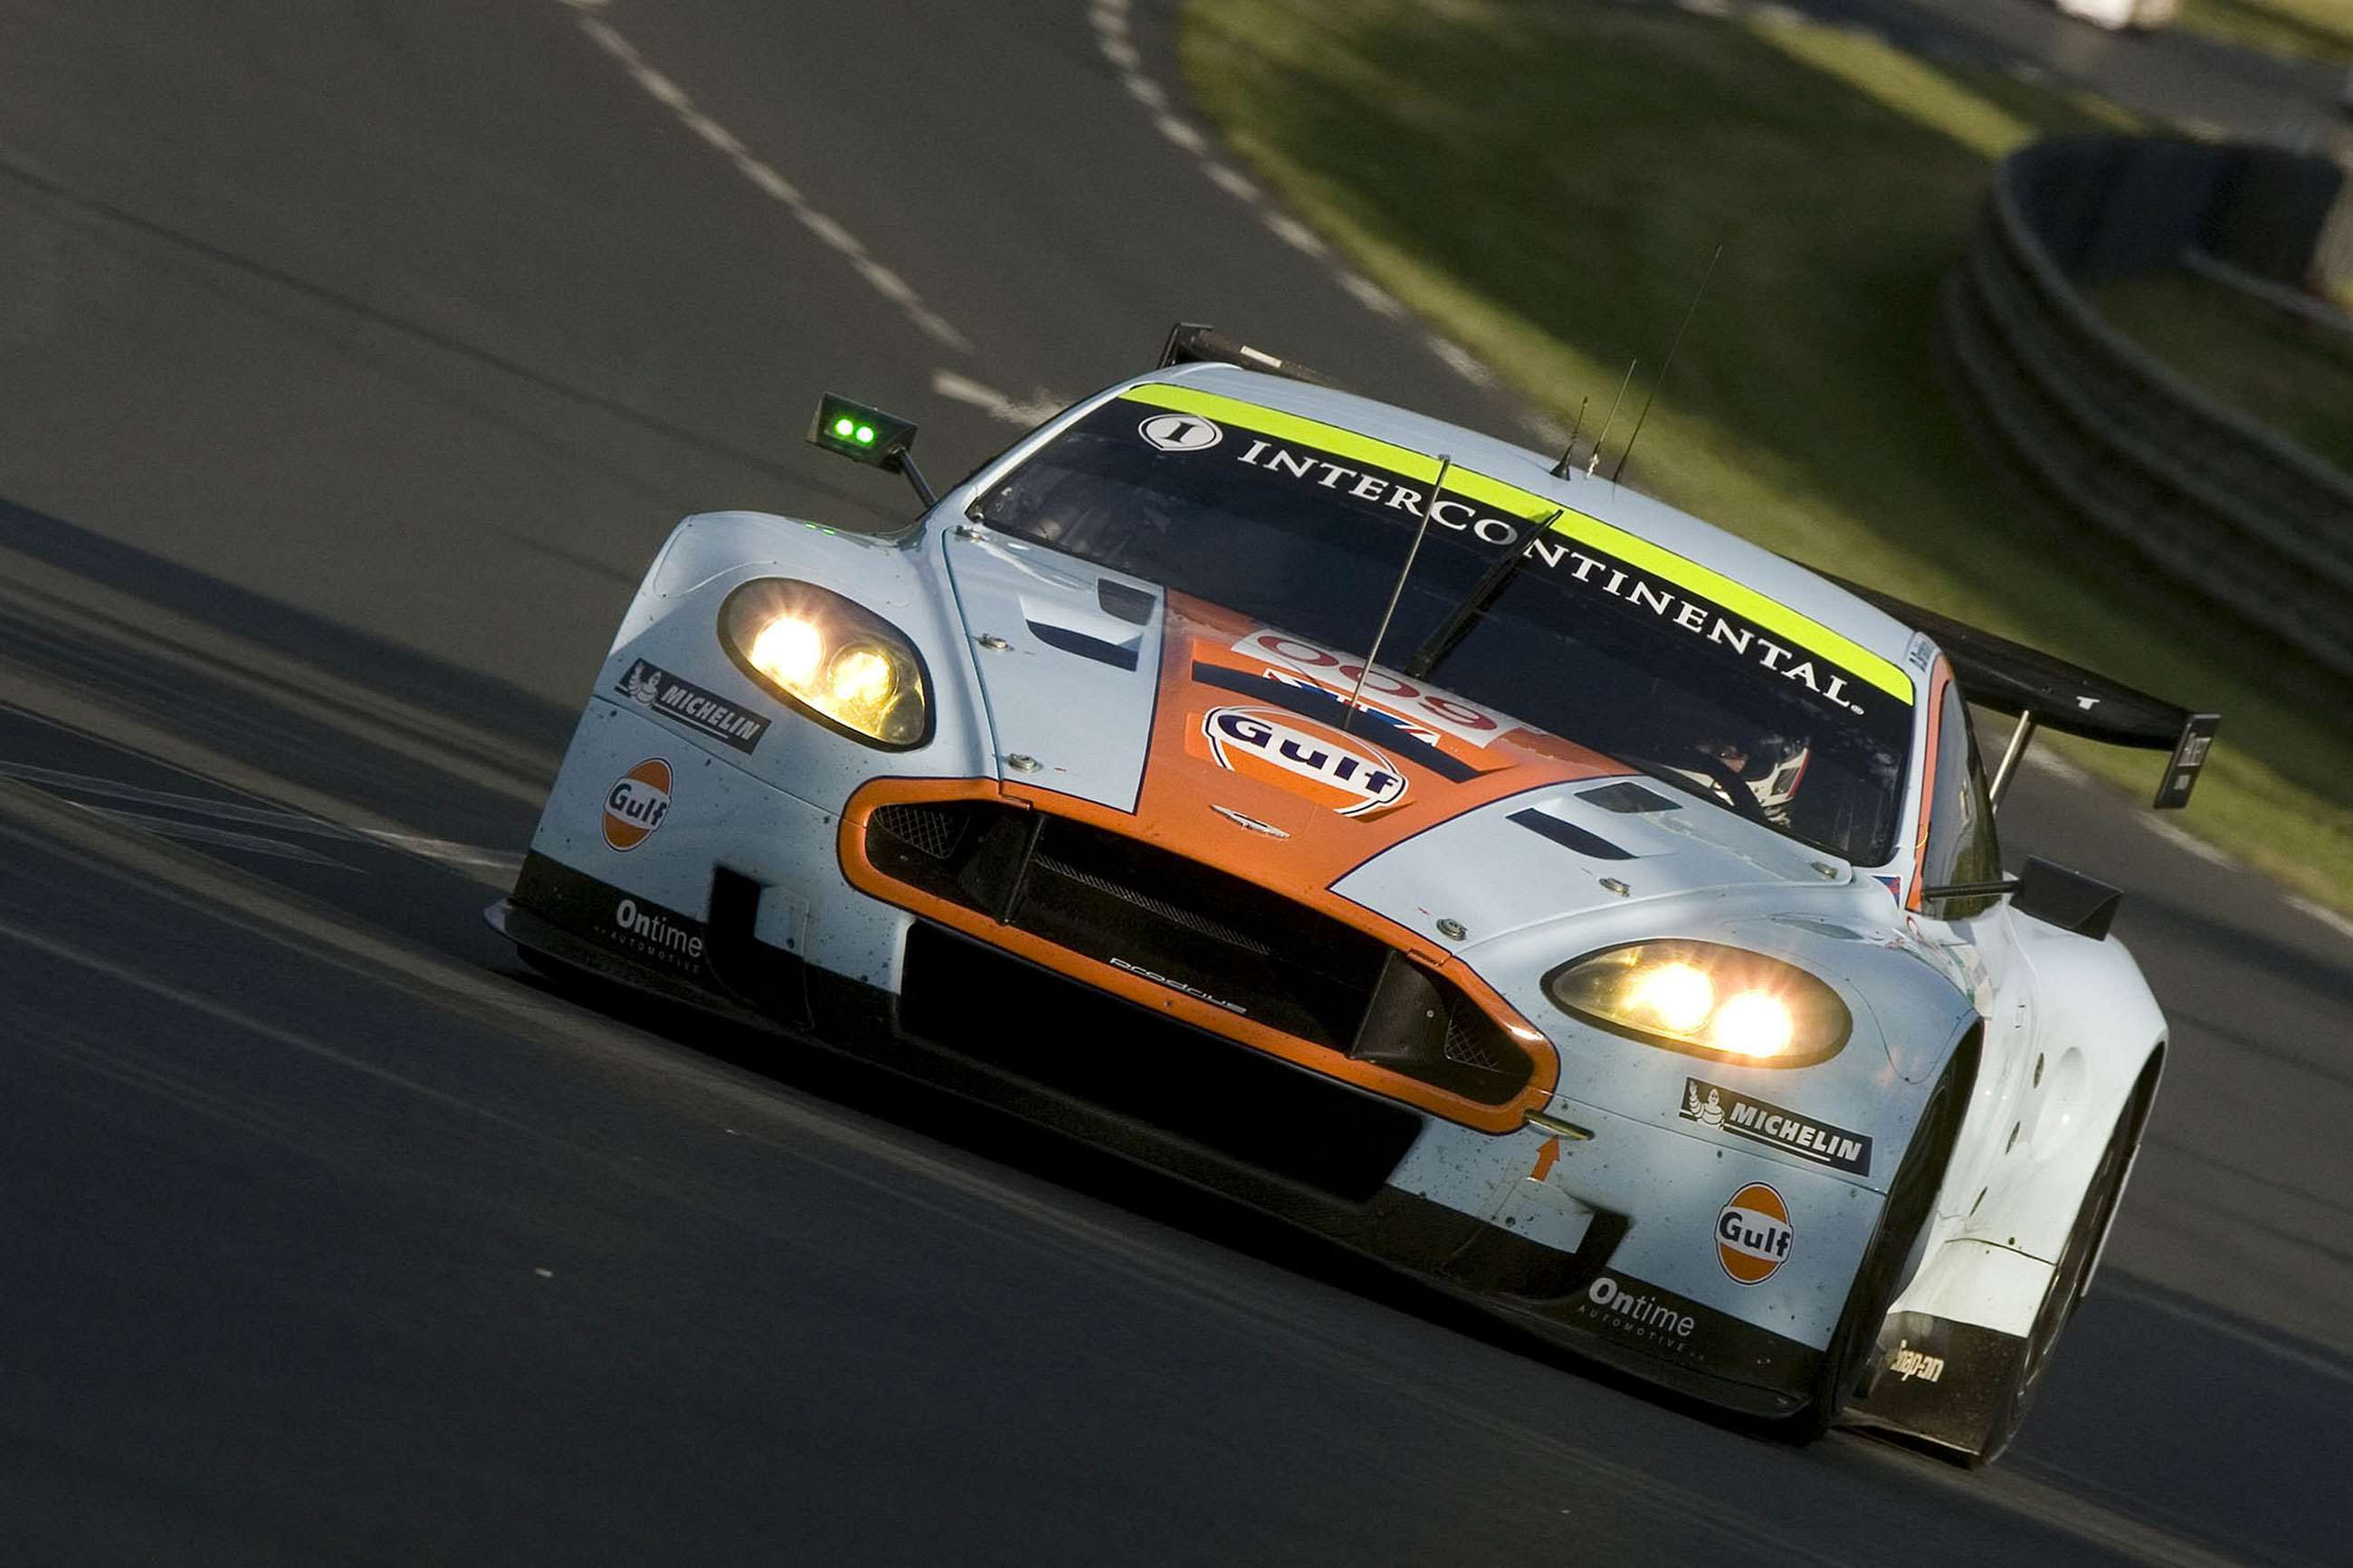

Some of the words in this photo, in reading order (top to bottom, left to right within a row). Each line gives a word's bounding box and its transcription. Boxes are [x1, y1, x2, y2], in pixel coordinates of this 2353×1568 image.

[1257, 635, 1498, 730] 009
[661, 686, 761, 740] MICHELIN
[1217, 714, 1398, 794] Gulf
[609, 783, 667, 826] Gulf
[610, 931, 700, 974] AUTOMOTIVE
[616, 898, 702, 957] Ontime
[1729, 1103, 1862, 1162] MICHELIN
[1720, 1212, 1790, 1257] Gulf
[1577, 1305, 1685, 1353] AUTOMOTIVE
[1588, 1277, 1695, 1336] Ontime
